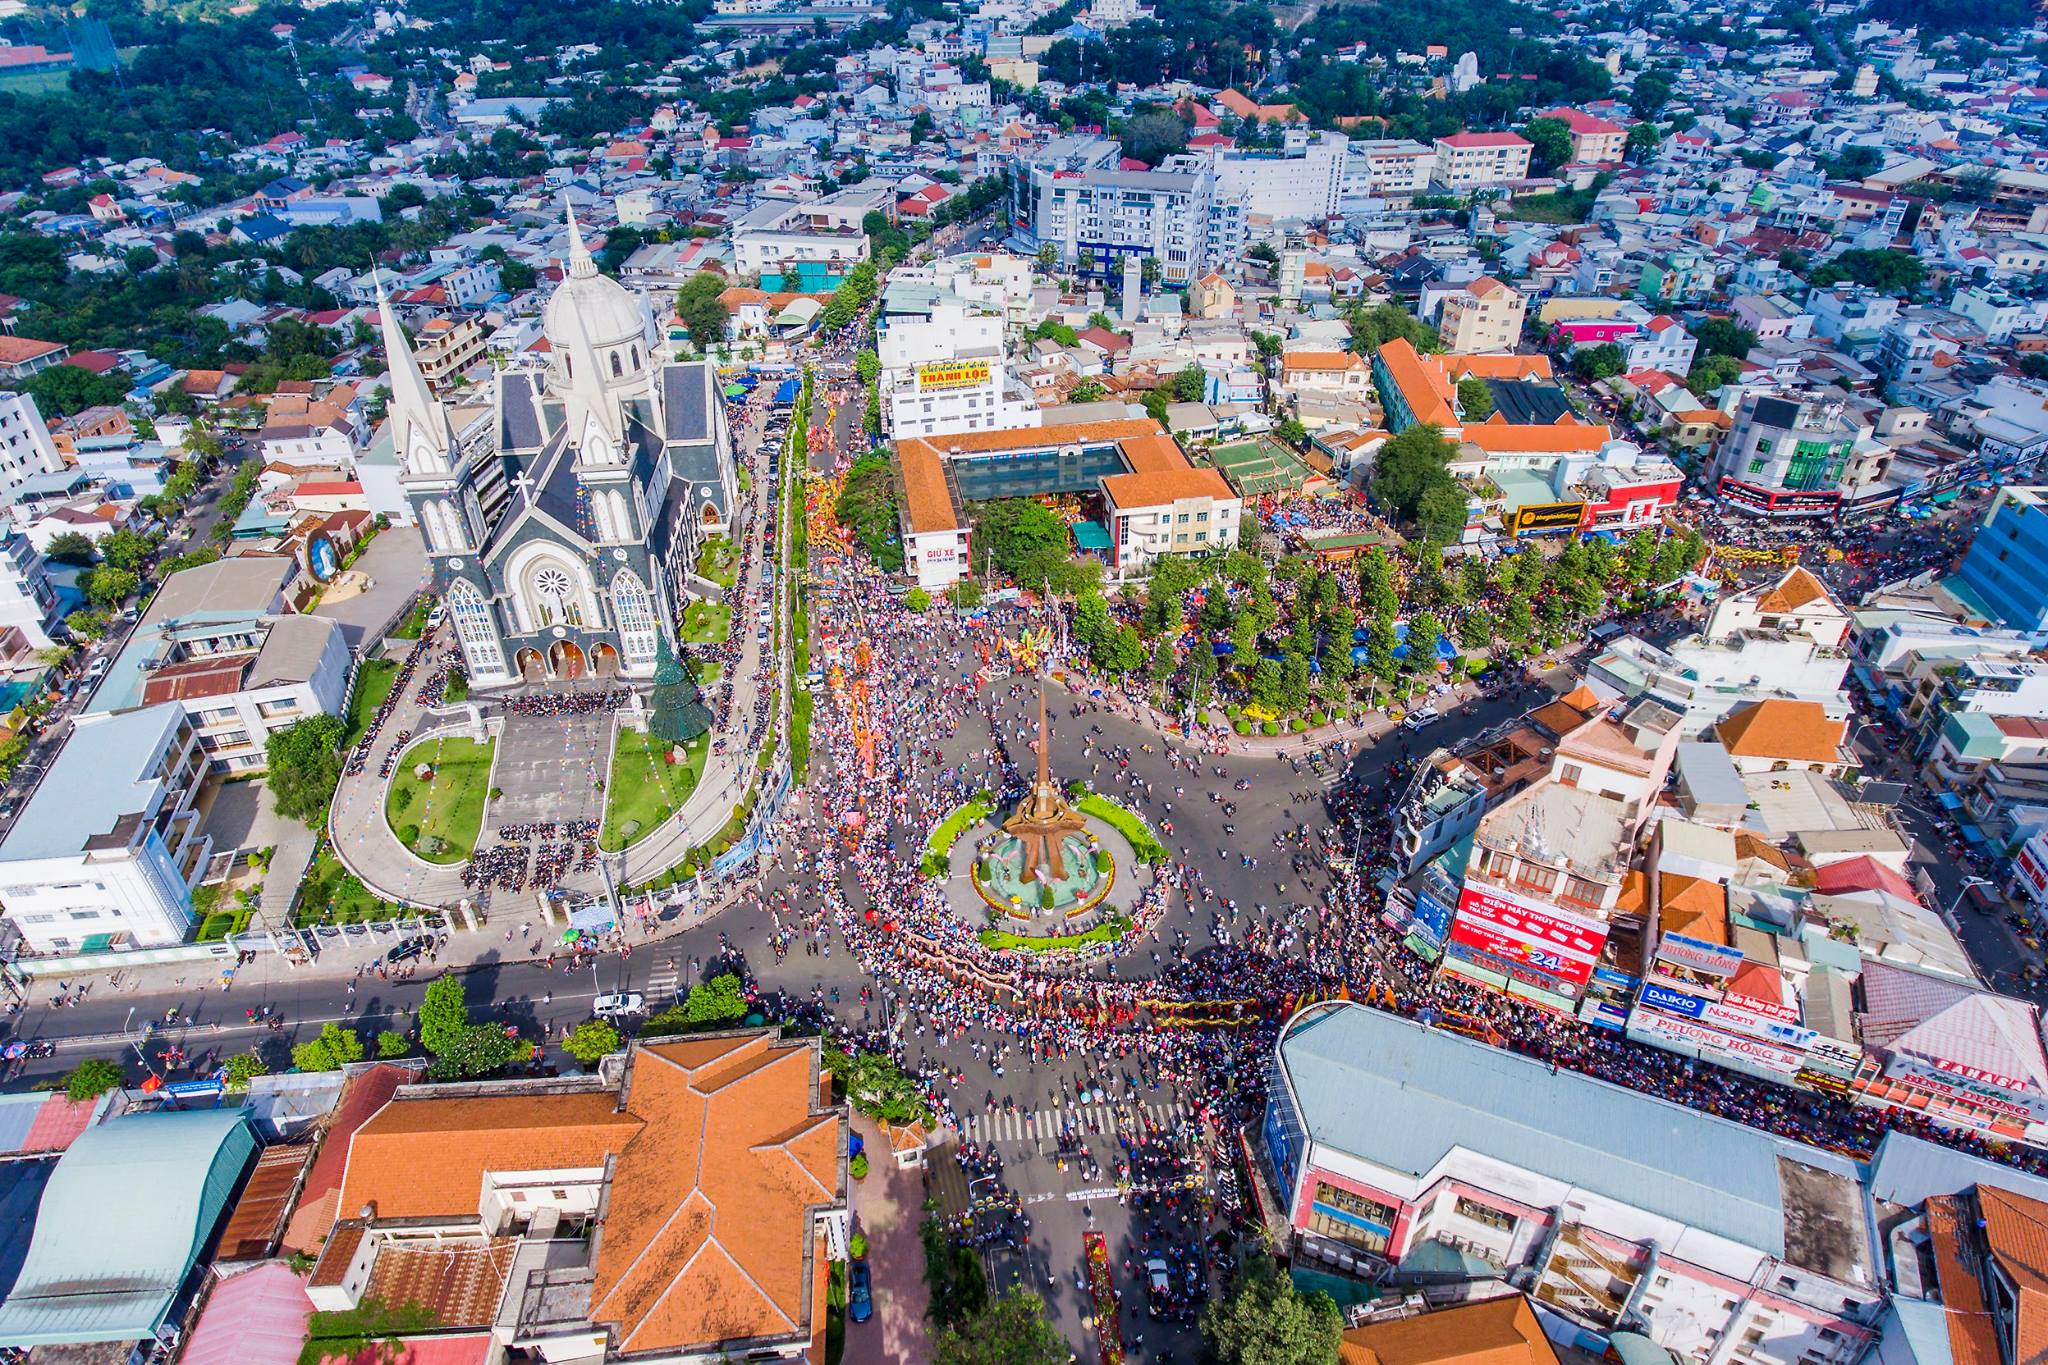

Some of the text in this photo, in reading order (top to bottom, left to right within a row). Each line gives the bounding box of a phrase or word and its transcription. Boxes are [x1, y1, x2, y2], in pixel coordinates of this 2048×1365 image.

[921, 368, 988, 383] THÀNH LỘC
[944, 549, 955, 557] XE
[1483, 897, 1507, 911] ĐIỆN
[1507, 903, 1528, 917] MÁY
[1555, 919, 1584, 935] NGÂN
[1528, 949, 1559, 971] 24
[1648, 988, 1697, 1009] DAIKIO
[1726, 991, 1743, 1004] Bán
[1743, 996, 1765, 1012] hàng
[1765, 1001, 1779, 1013] trả
[1778, 1007, 1797, 1021] góp
[1655, 1016, 1723, 1045] PHƯƠNG
[1727, 1039, 1775, 1059] HỒNG
[1937, 1059, 2025, 1092] FAHASA
[1903, 1073, 2031, 1117] BÌNH DƯƠNG
